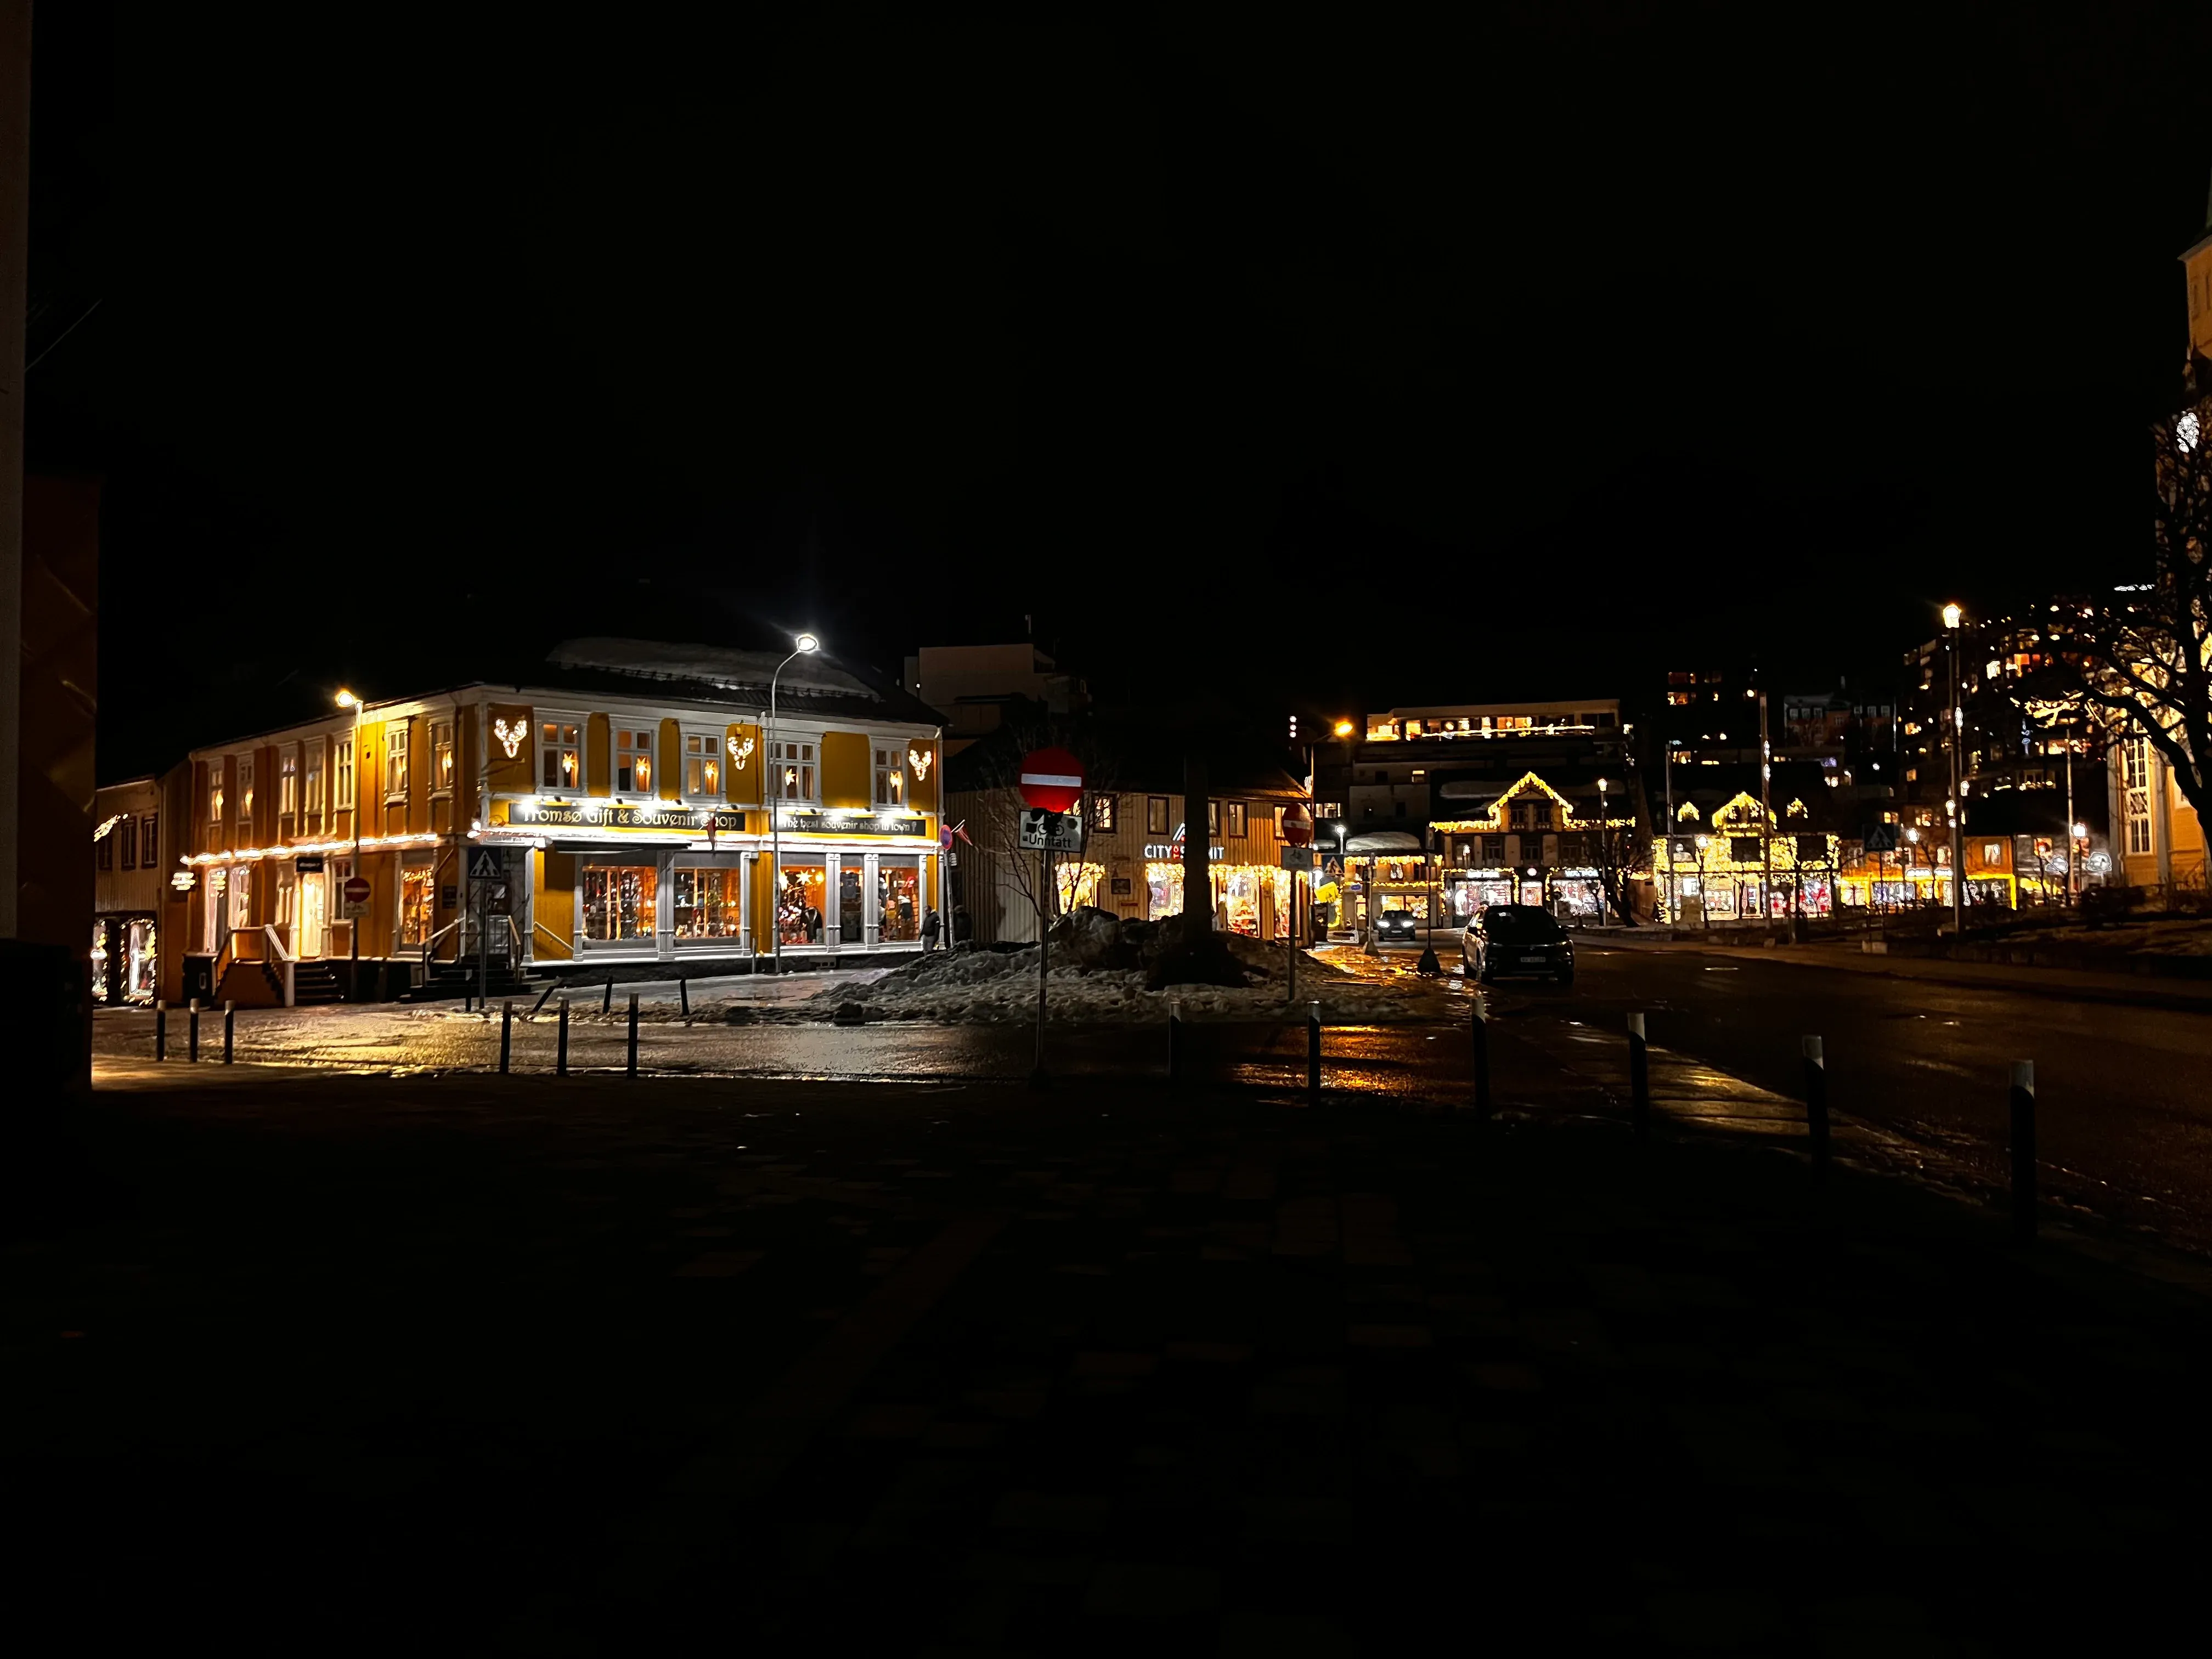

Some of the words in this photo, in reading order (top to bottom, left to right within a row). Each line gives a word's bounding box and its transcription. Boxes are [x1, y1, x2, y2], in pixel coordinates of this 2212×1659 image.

[586, 808, 613, 826] Gift
[617, 809, 629, 823] &
[632, 809, 698, 826] Souvenir
[821, 820, 858, 830] souvenir
[859, 821, 879, 832] shop
[1029, 833, 1072, 848] Unntatt
[1144, 844, 1172, 859] CITY
